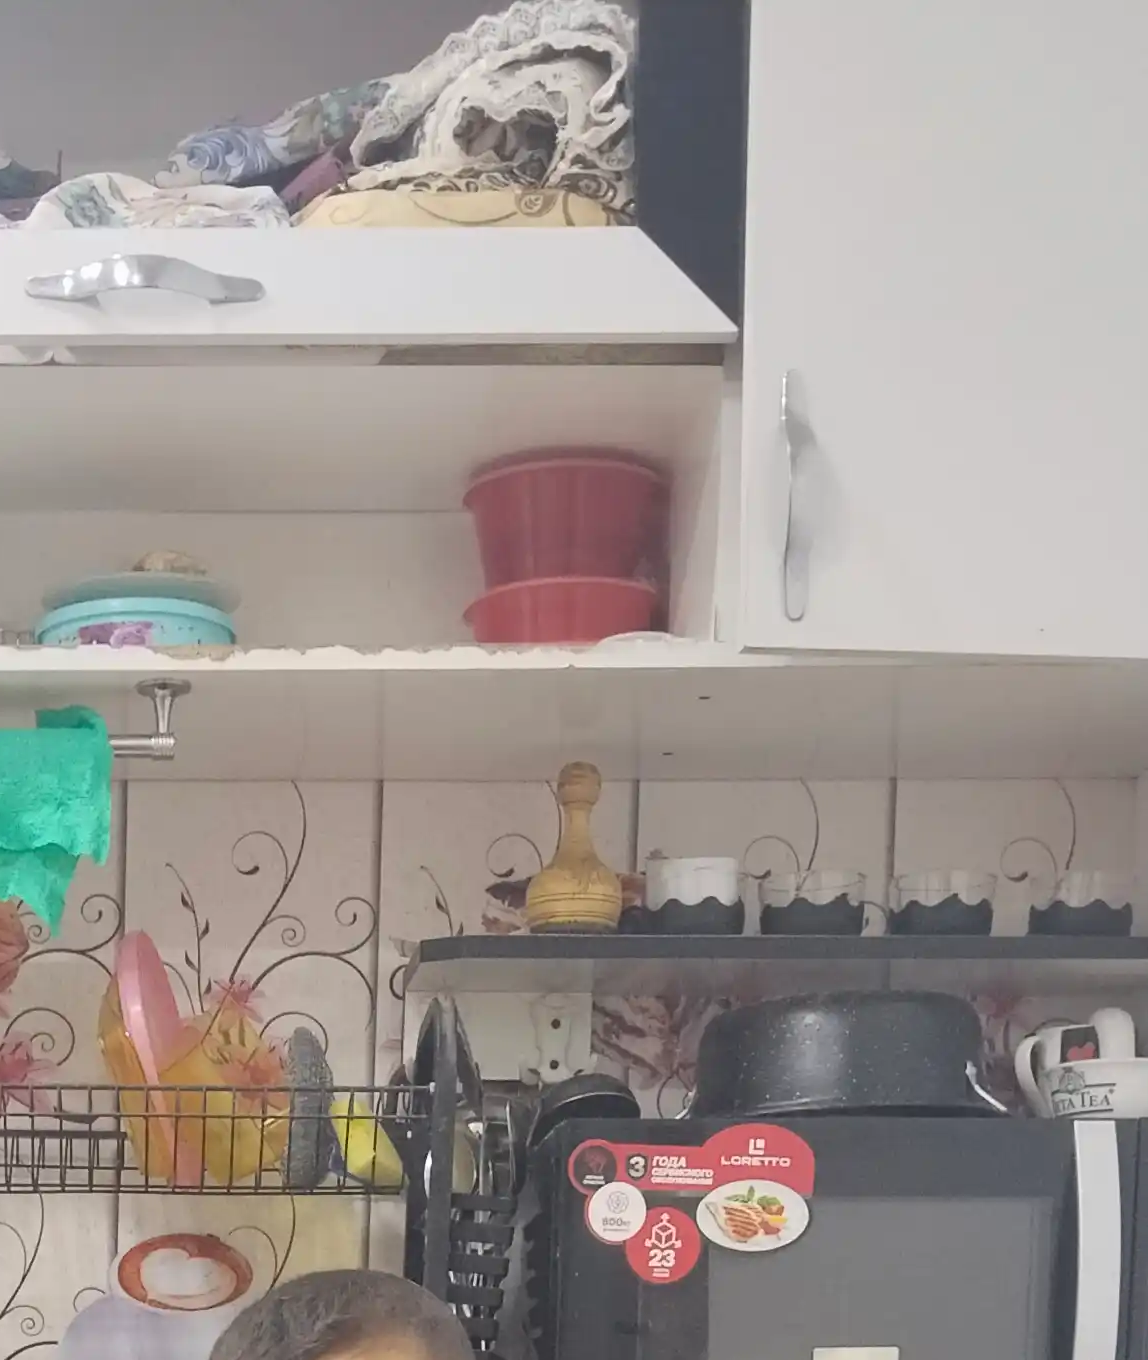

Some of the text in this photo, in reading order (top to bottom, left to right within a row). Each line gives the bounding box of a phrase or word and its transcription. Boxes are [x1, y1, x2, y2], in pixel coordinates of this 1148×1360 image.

[628, 1155, 687, 1178] 3 ГОДА
[720, 1155, 792, 1168] LORETTO
[648, 1249, 676, 1268] 23
